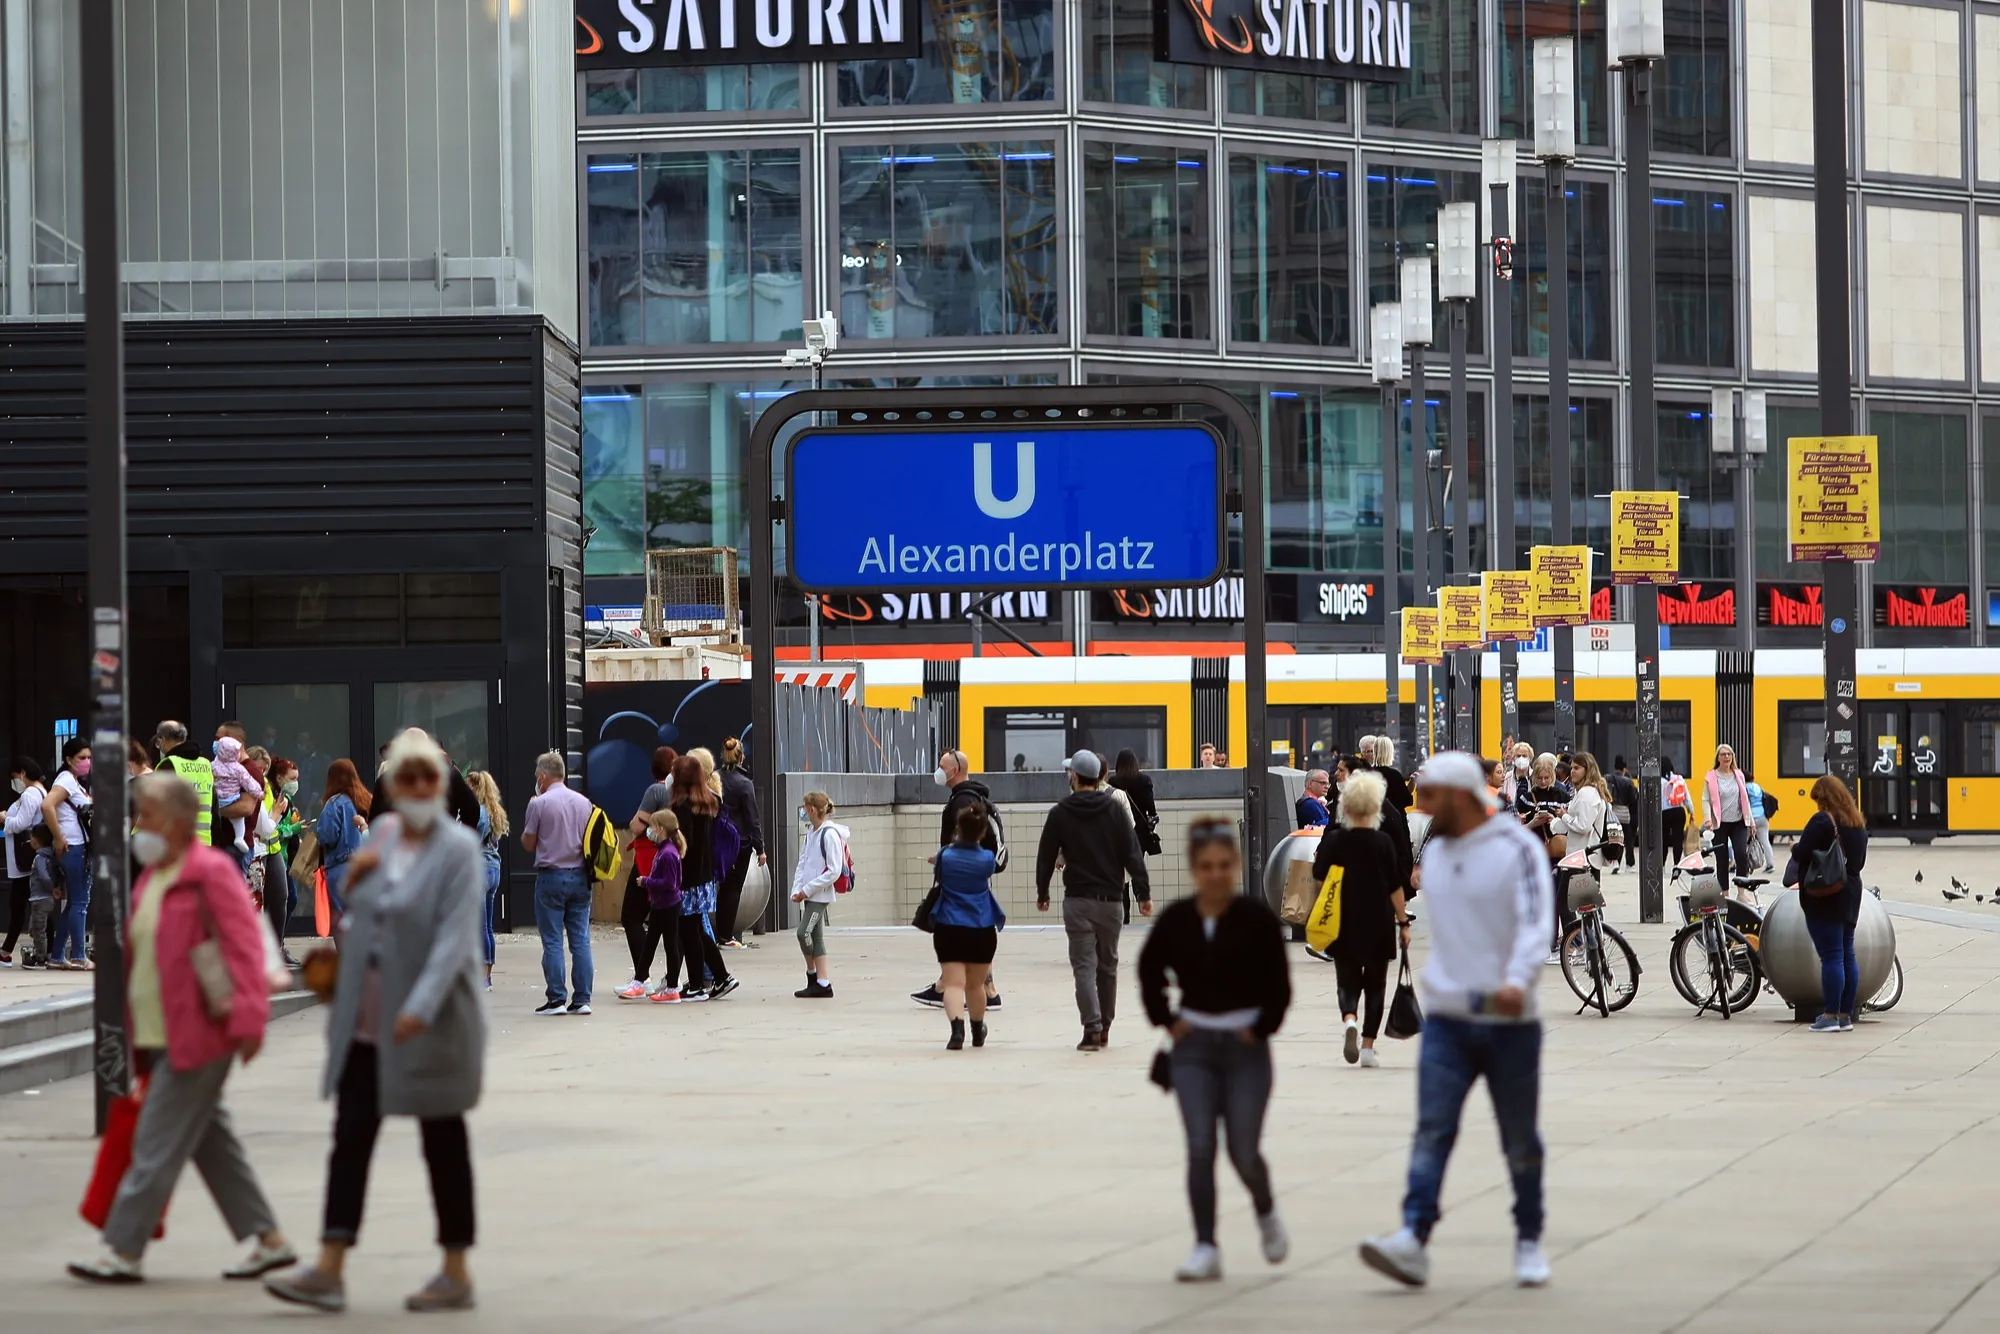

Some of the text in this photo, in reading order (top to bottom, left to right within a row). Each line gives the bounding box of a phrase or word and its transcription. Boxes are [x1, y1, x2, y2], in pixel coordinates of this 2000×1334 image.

[1257, 0, 1411, 68] SATURN
[1806, 453, 1861, 463] Für eine Stadt
[1804, 465, 1868, 474] mit bezahlbaren
[973, 441, 1036, 519] U
[1821, 475, 1848, 483] Mieten
[1826, 486, 1857, 496] für alle.
[1824, 503, 1844, 511] Jetzt
[1803, 513, 1865, 522] unterschreiben.
[858, 530, 1155, 581] Alexanderplatz
[1592, 628, 1608, 637] U2
[1592, 640, 1608, 650] U5
